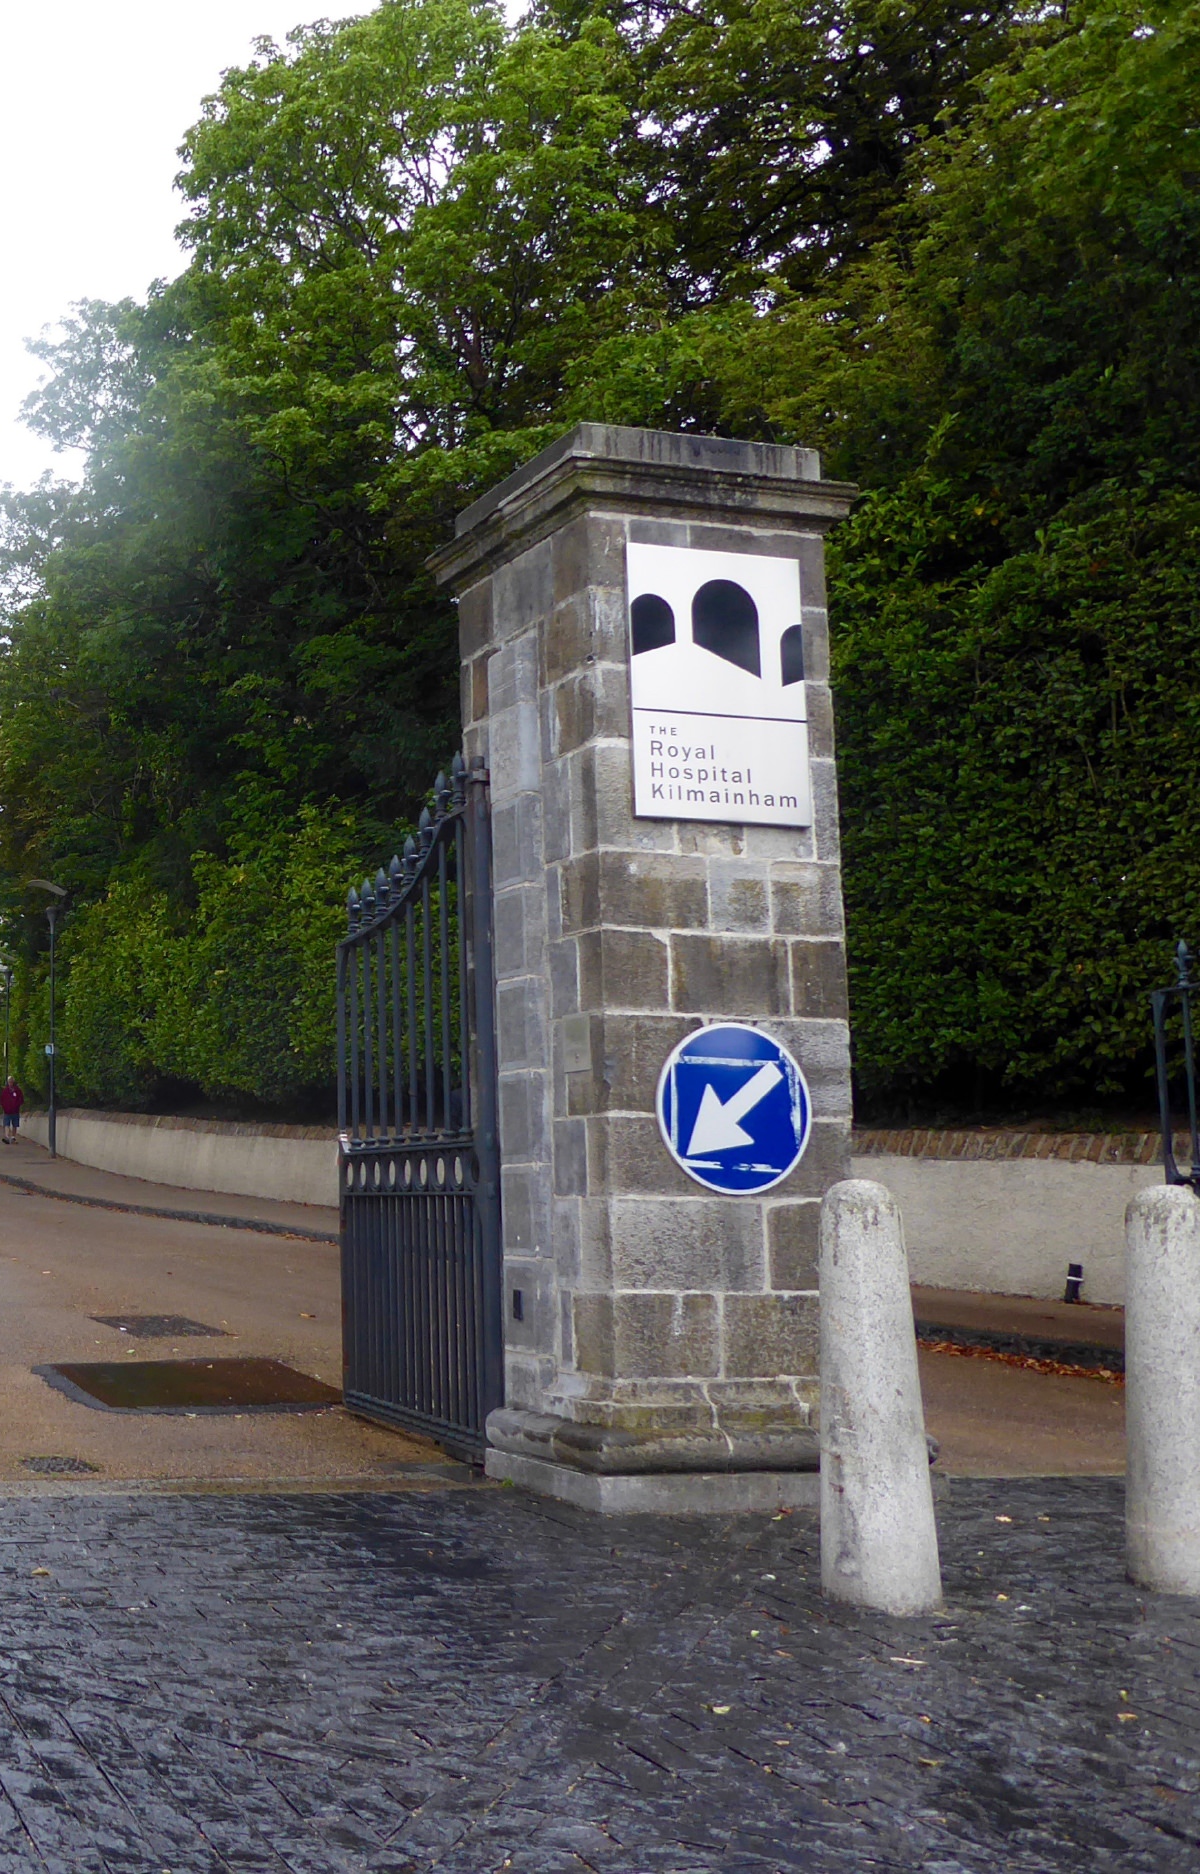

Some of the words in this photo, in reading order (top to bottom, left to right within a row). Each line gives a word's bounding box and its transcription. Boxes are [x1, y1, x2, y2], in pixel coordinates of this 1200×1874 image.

[649, 725, 678, 736] THE
[650, 740, 715, 762] Royal
[650, 761, 752, 784] Hospital
[651, 783, 798, 809] Kilmainham
